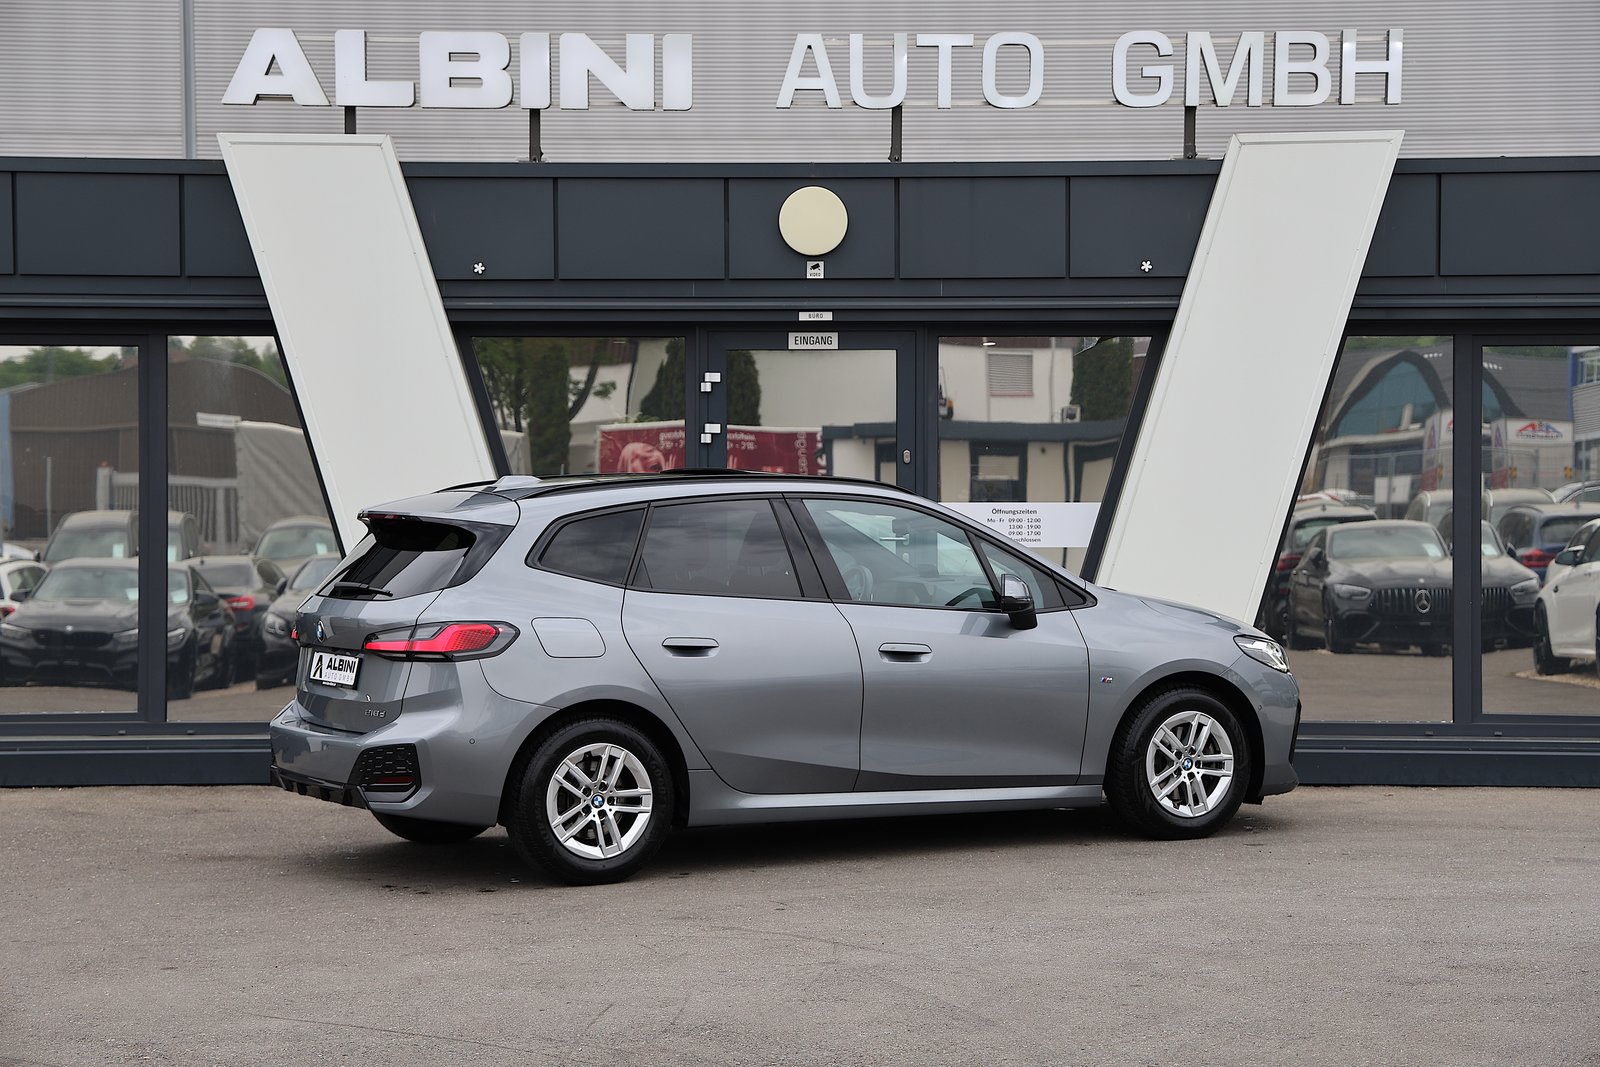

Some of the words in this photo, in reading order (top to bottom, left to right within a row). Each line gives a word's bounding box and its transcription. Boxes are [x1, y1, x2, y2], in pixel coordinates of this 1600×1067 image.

[222, 27, 693, 110] ALBINI
[775, 32, 1044, 109] AUTO
[1112, 28, 1404, 107] GMBH
[794, 335, 833, 346] EINGANG
[992, 507, 1037, 515] Öffnungszeiten
[326, 657, 356, 673] ALBINI
